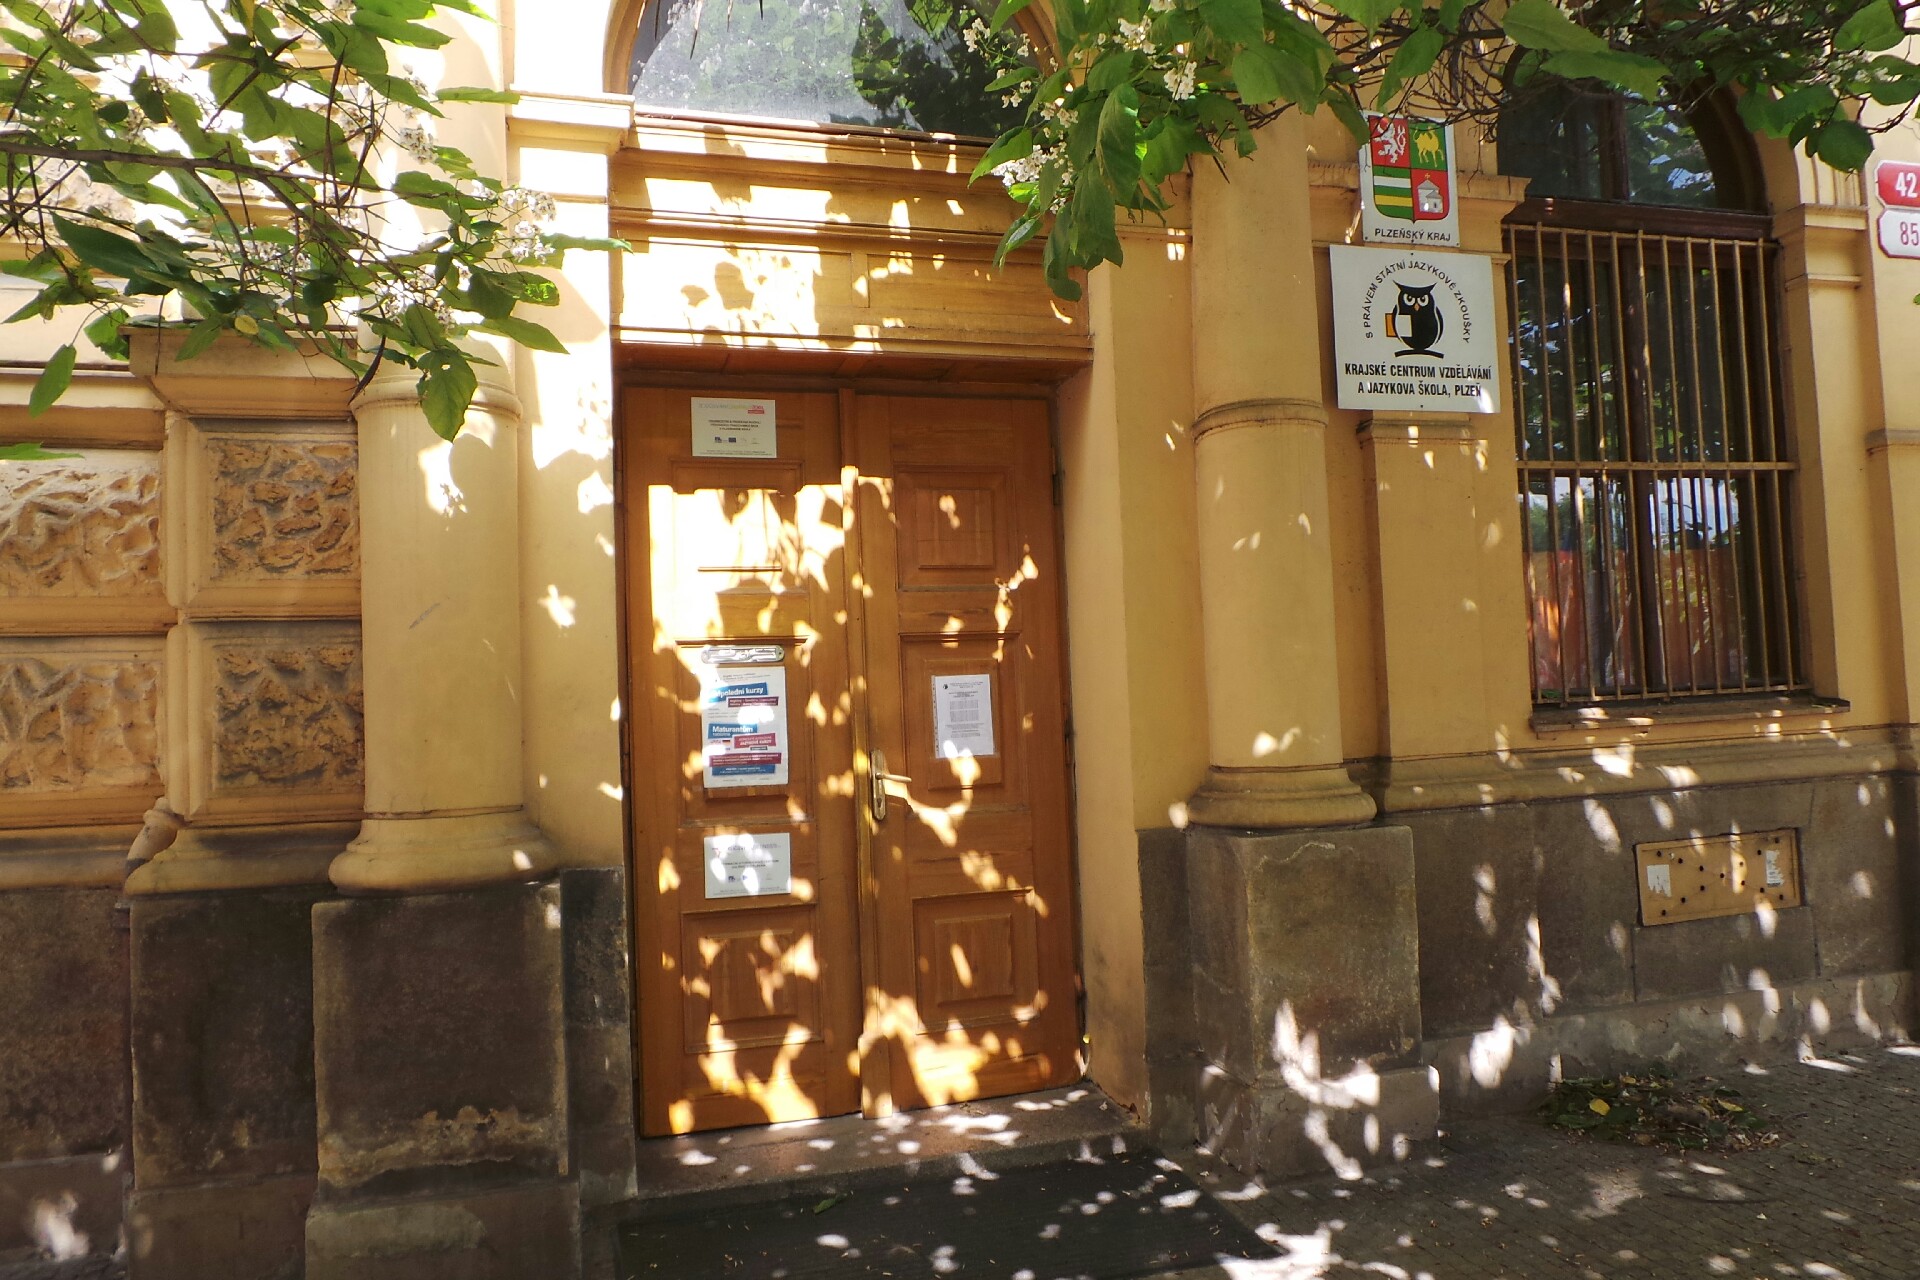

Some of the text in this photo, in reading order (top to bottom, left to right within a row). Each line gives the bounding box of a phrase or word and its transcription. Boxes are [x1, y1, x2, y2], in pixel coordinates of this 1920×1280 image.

[1895, 172, 1918, 198] 42
[1375, 228, 1451, 241] PLZEŇSKÝ KRAJ
[1362, 260, 1472, 343] S PRÁVEM STÁTNÍ JAZYKOVÉ ZKOUŠKY
[1345, 362, 1491, 380] KRAJSKÉ CENTRUM VZDĚLÁVÁNÍ
[1358, 382, 1364, 394] A
[1418, 380, 1451, 398] ŠKOLA,
[1455, 382, 1481, 397] PLZEŇ
